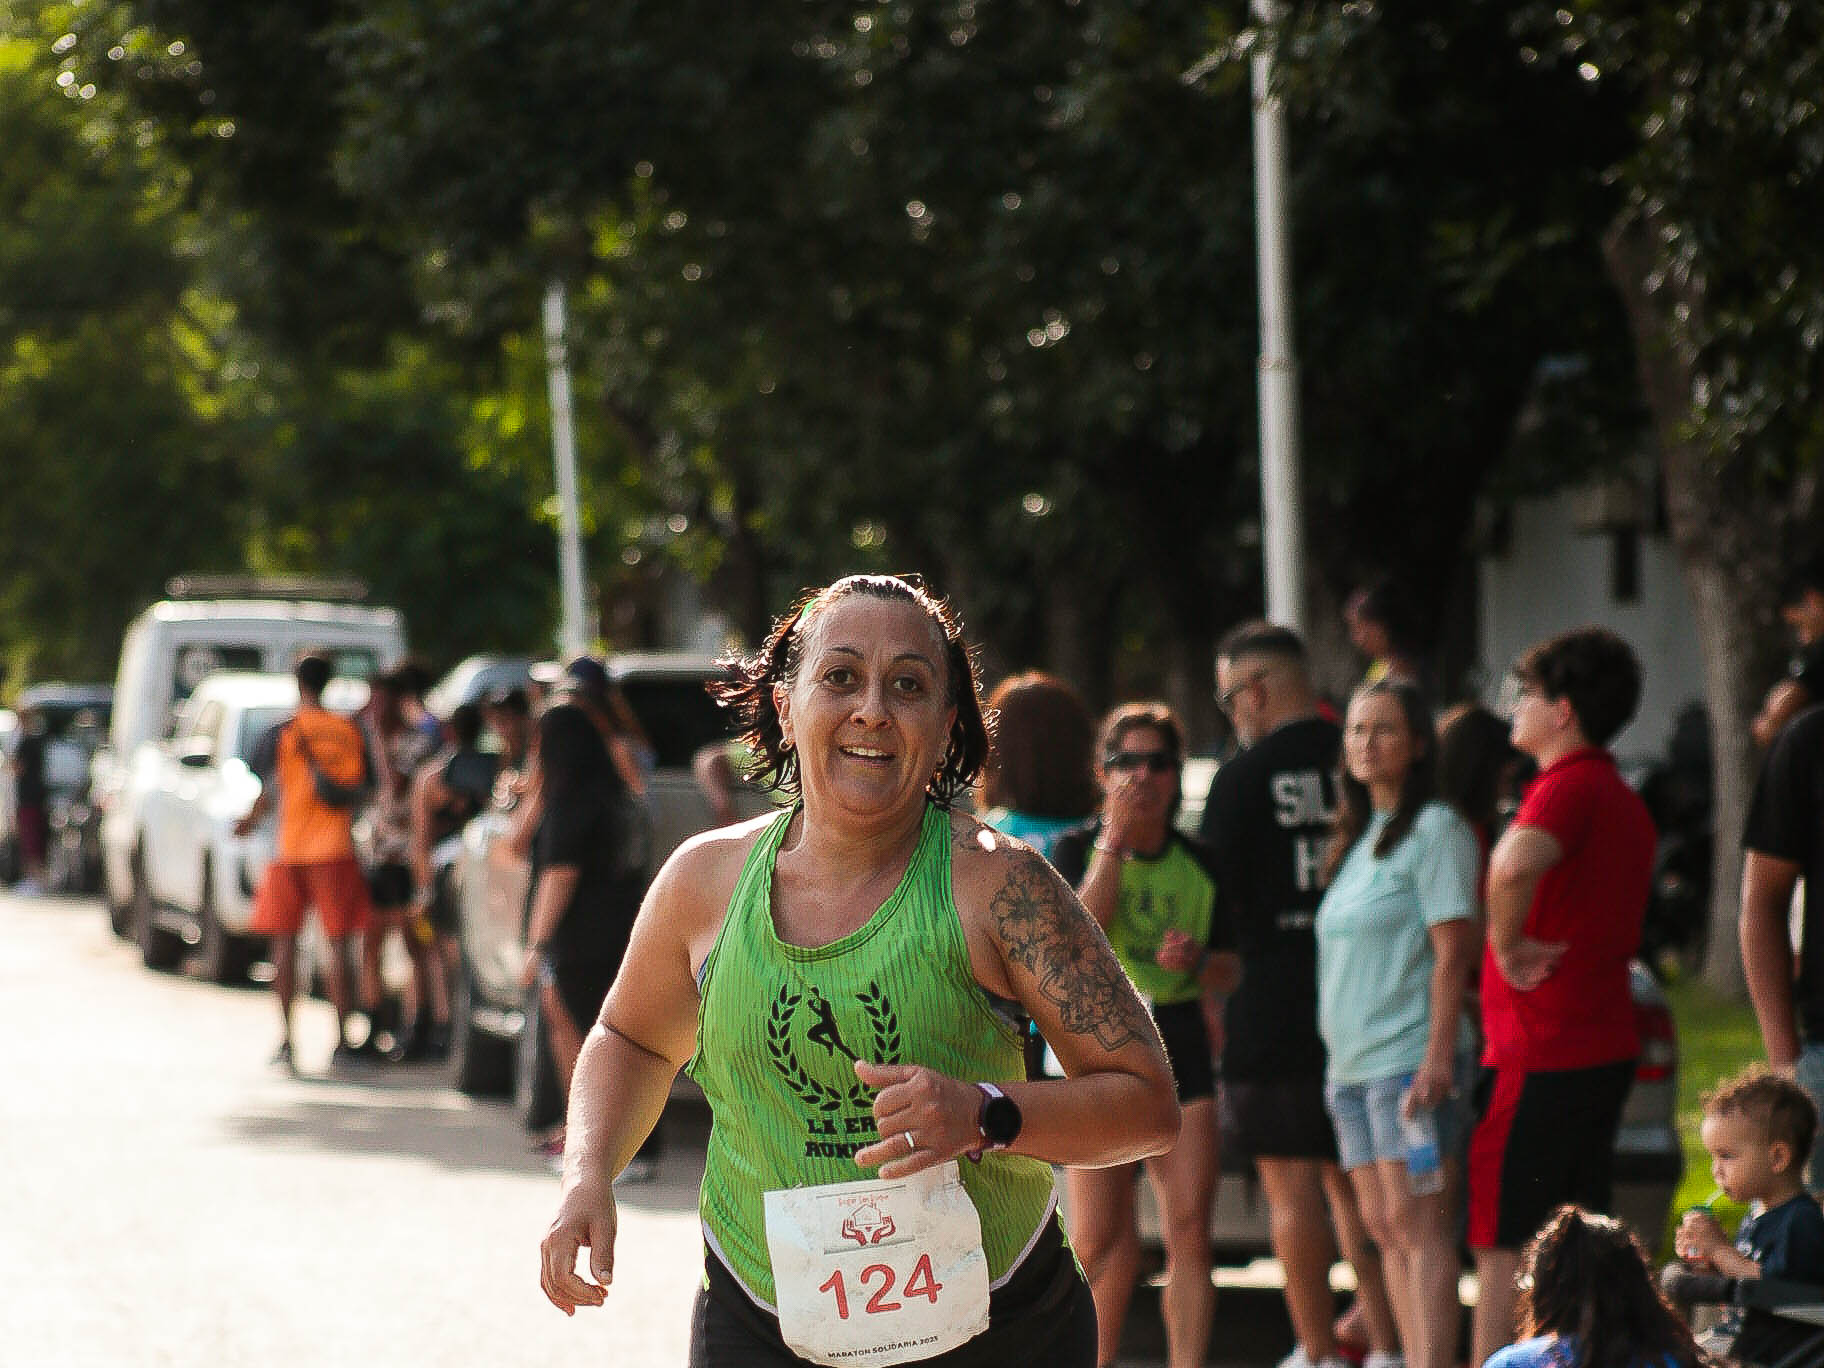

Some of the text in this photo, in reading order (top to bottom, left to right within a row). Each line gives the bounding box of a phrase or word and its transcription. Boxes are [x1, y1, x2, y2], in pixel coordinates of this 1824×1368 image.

[844, 1116, 879, 1133] ER
[818, 1253, 943, 1319] 124
[827, 1347, 871, 1359] MARATON
[872, 1340, 918, 1353] SOLIDARIA
